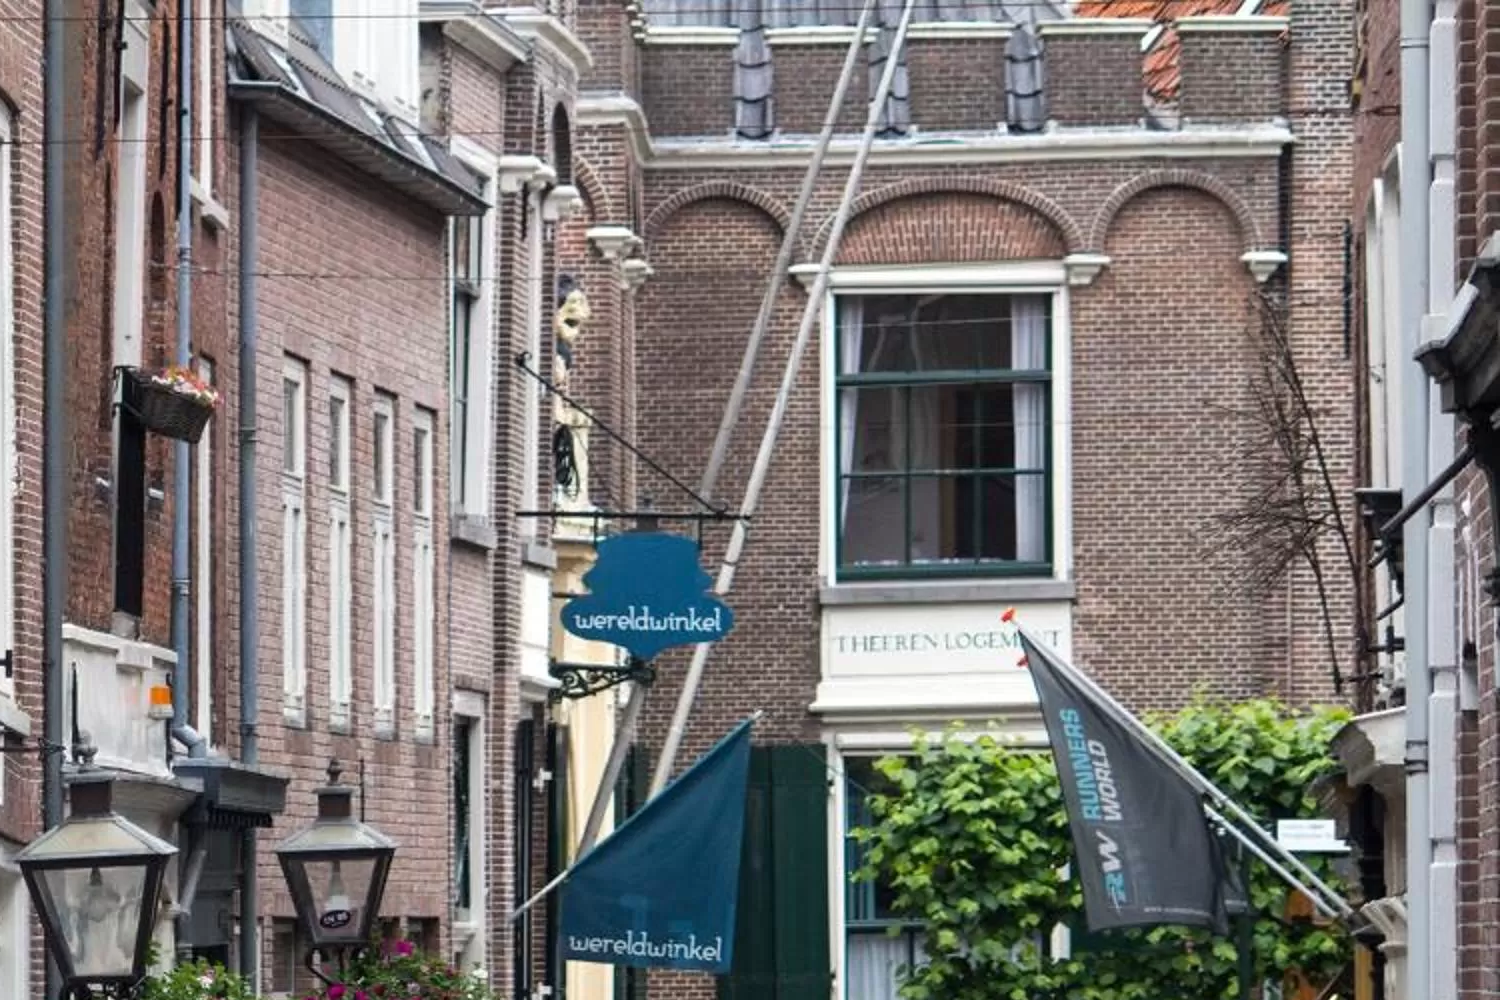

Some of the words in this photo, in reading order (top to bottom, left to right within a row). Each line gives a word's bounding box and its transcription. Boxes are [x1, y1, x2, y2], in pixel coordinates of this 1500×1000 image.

[573, 605, 722, 632] wereldwinkel
[1059, 707, 1100, 821] RUNNERS
[1087, 739, 1124, 822] WORLD
[568, 929, 722, 962] wereldwinkel
